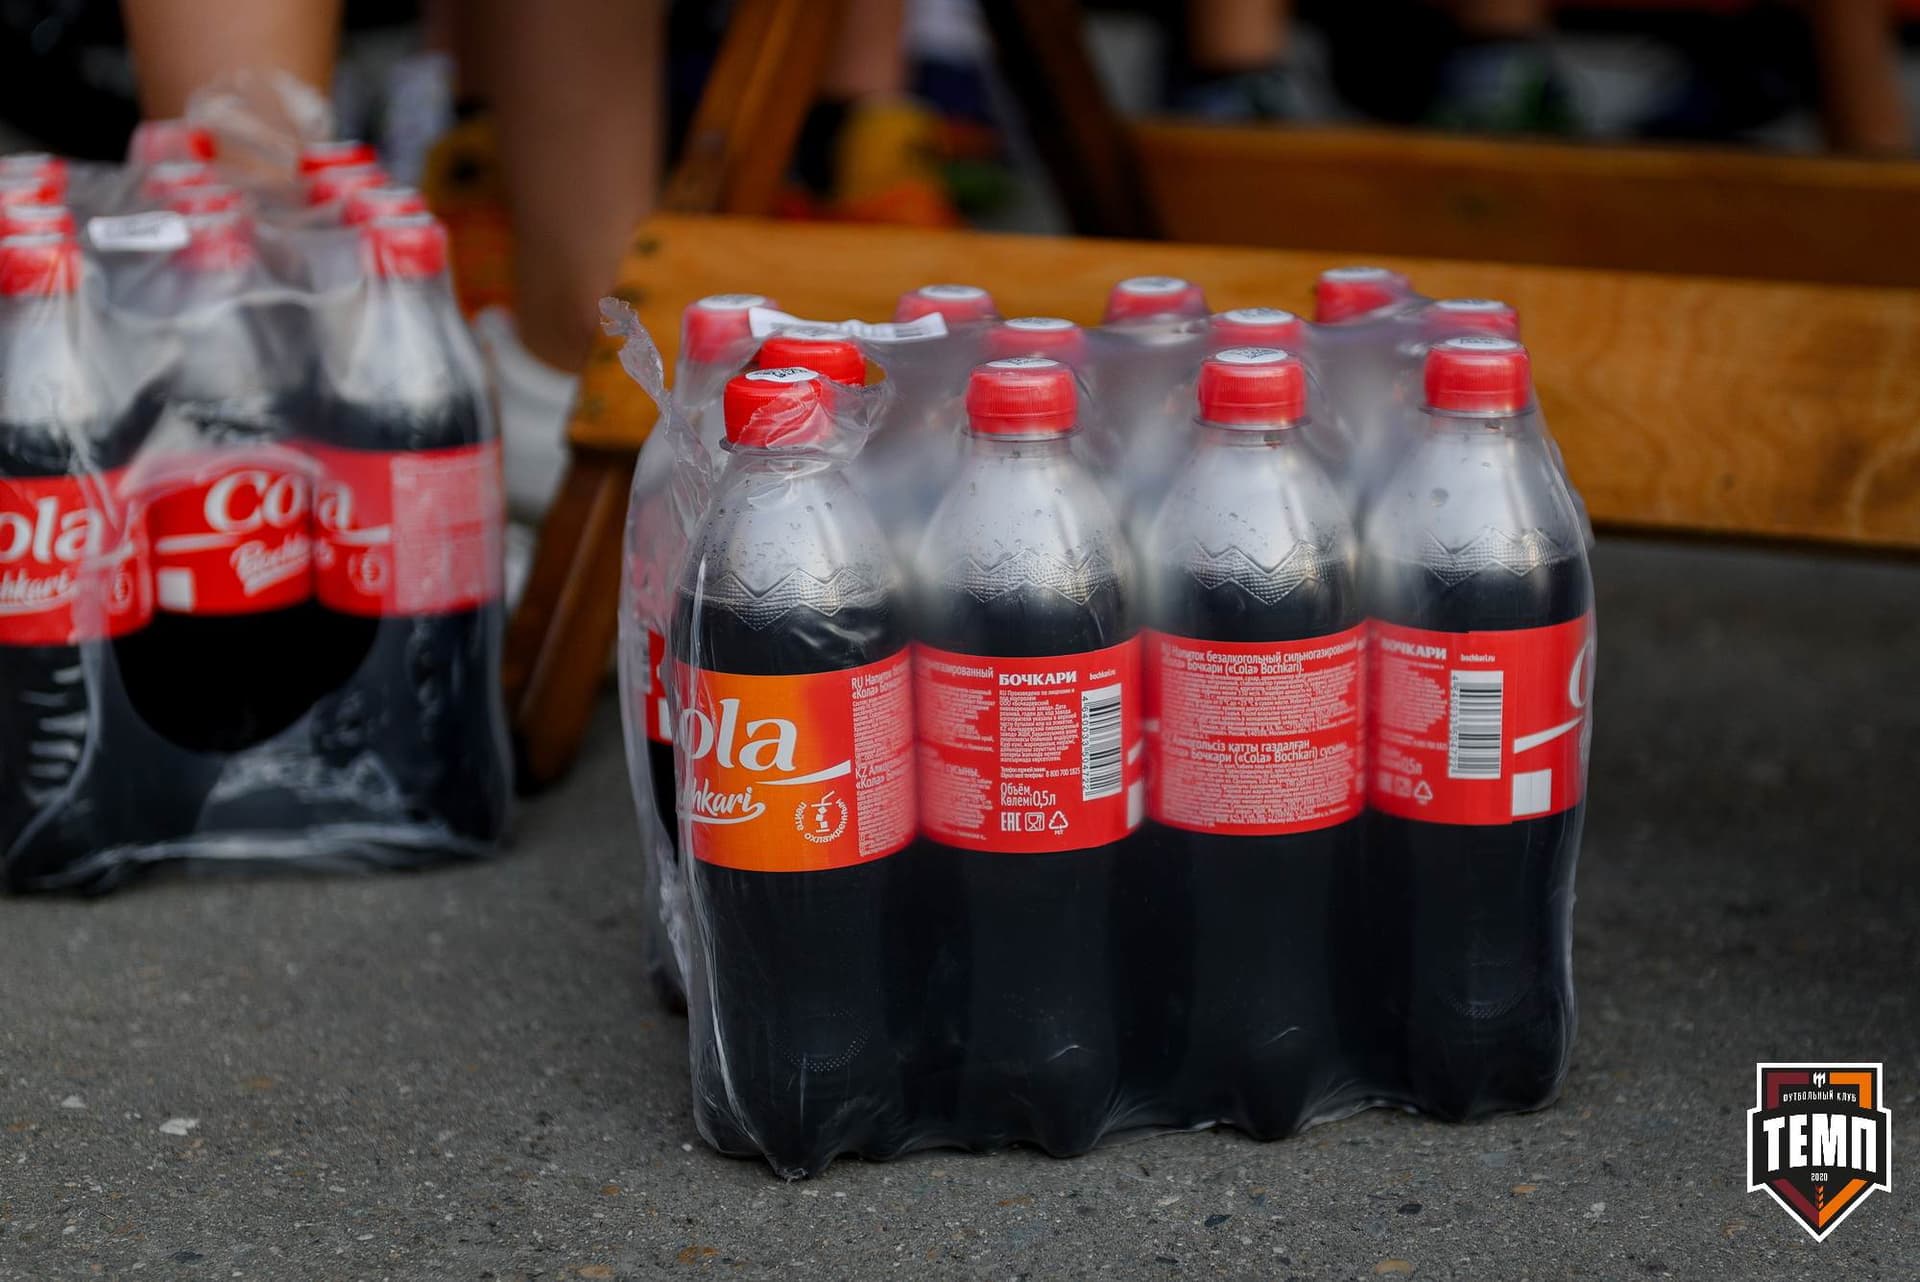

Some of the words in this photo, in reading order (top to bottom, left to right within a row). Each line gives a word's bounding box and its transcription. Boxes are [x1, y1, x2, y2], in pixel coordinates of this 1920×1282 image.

[1206, 651, 1281, 664] безалкогольный
[998, 670, 1078, 686] БОЧКАРИ
[1000, 782, 1030, 795] Объём
